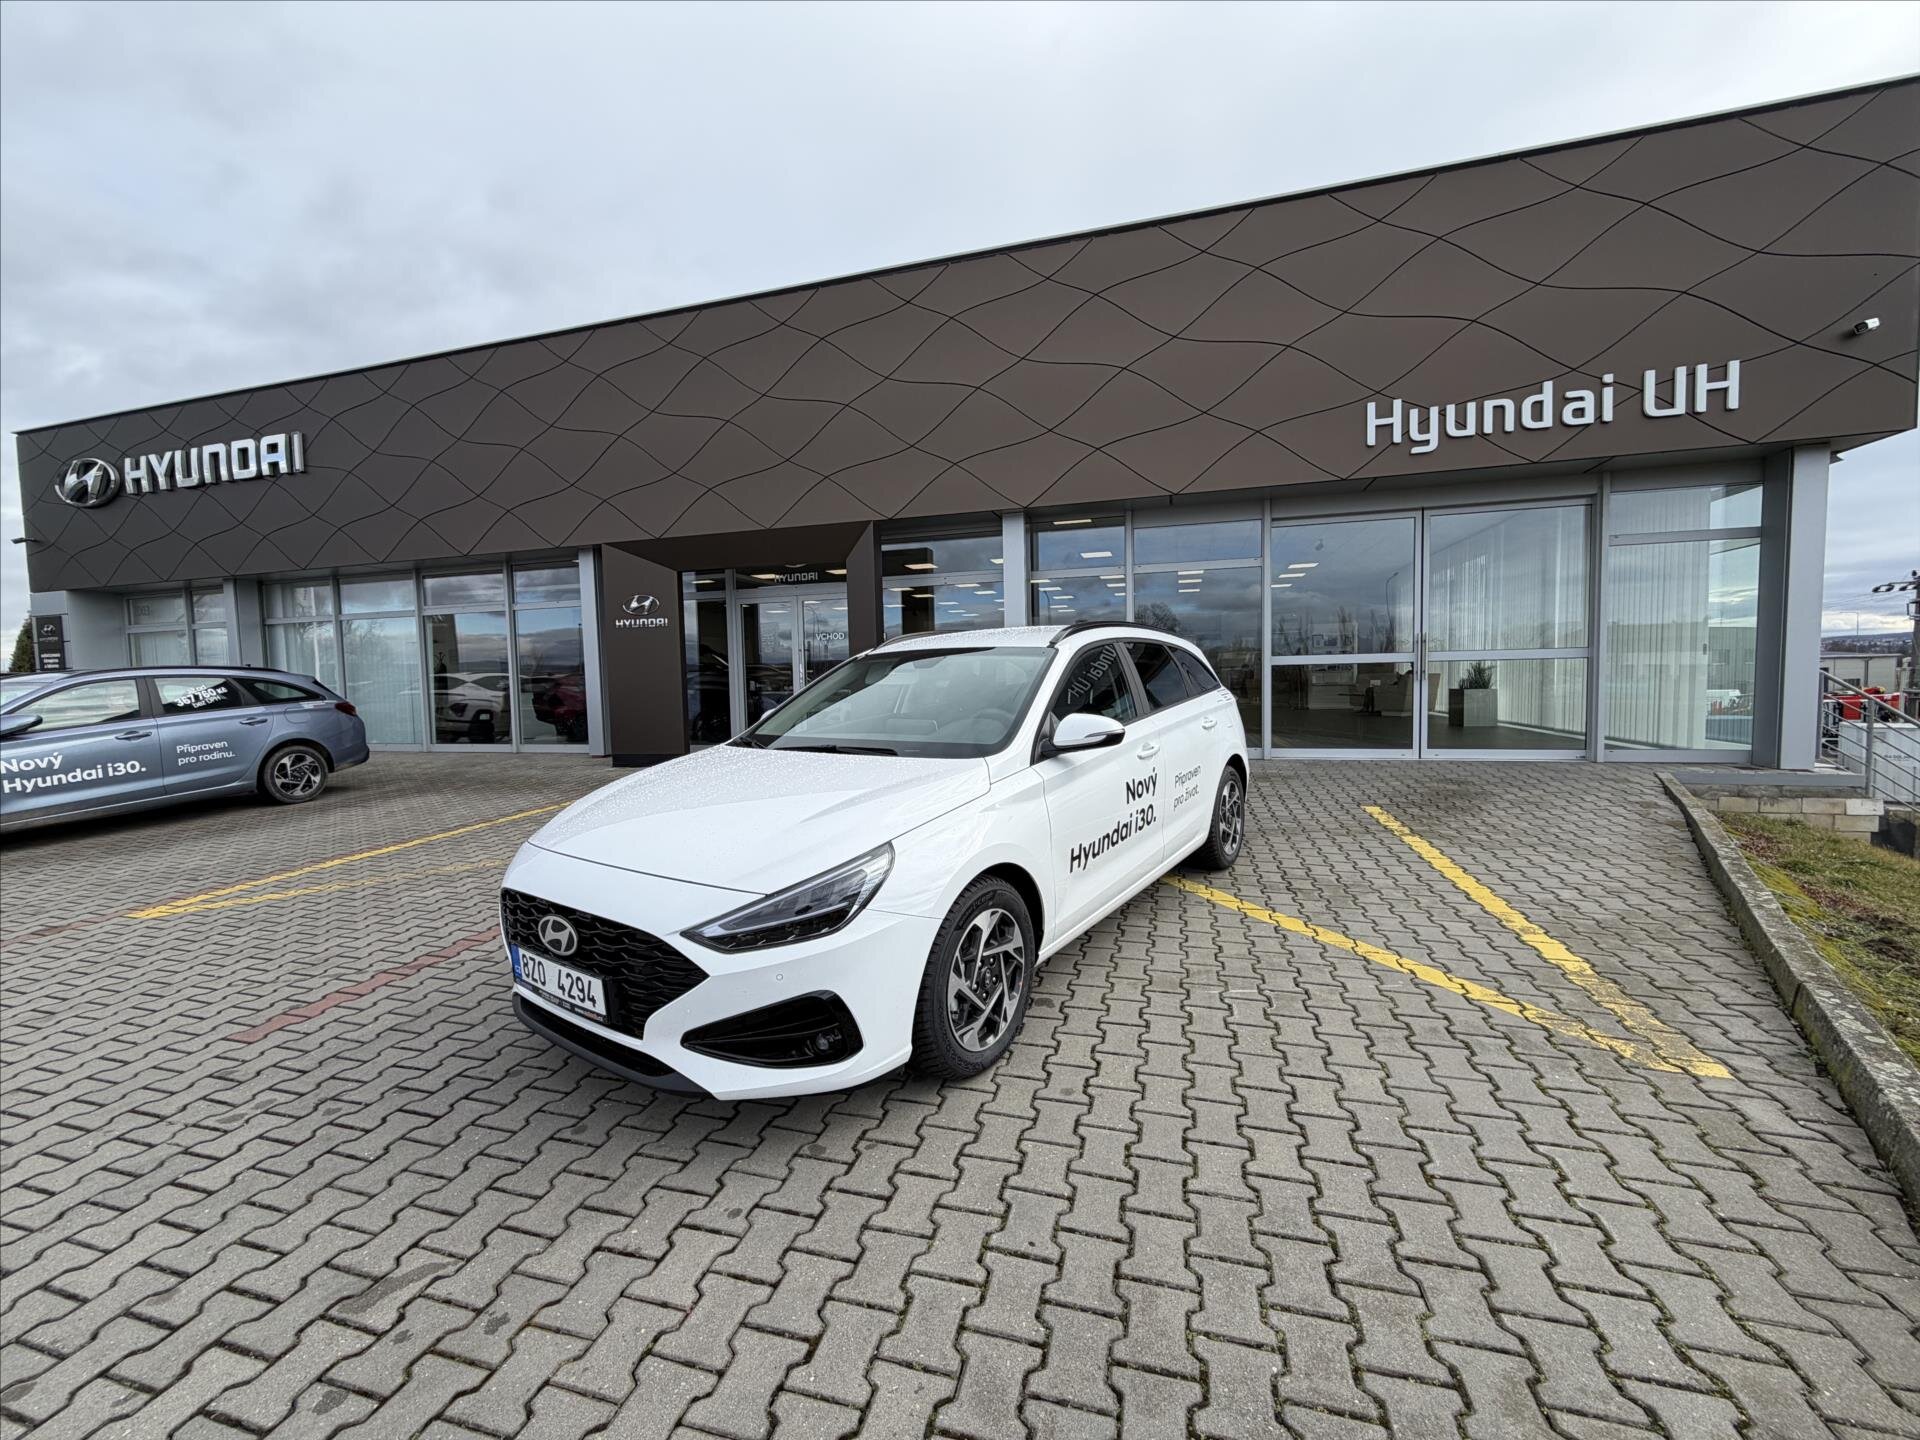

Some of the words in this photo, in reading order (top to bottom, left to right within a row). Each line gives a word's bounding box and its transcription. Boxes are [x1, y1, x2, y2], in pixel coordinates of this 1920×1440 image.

[1365, 373, 1615, 455] Hyundai
[1643, 360, 1741, 418] UH
[124, 431, 305, 494] HYUNDAI
[773, 571, 819, 583] HYUNDAI
[615, 617, 668, 628] HYUNDAI
[815, 632, 845, 641] VCHOD
[176, 739, 229, 755] Připraven
[178, 755, 197, 767] pro
[198, 749, 236, 762] rodinu.
[0, 751, 63, 775] Nový
[2, 767, 103, 794] Hyundai
[107, 759, 147, 777] i30.
[1125, 767, 1158, 805] Nový
[1174, 765, 1202, 789] Připraven
[1173, 793, 1185, 812] pro
[1069, 815, 1133, 874] Hyundai
[1134, 803, 1157, 835] i30.
[557, 968, 597, 1008] 4294
